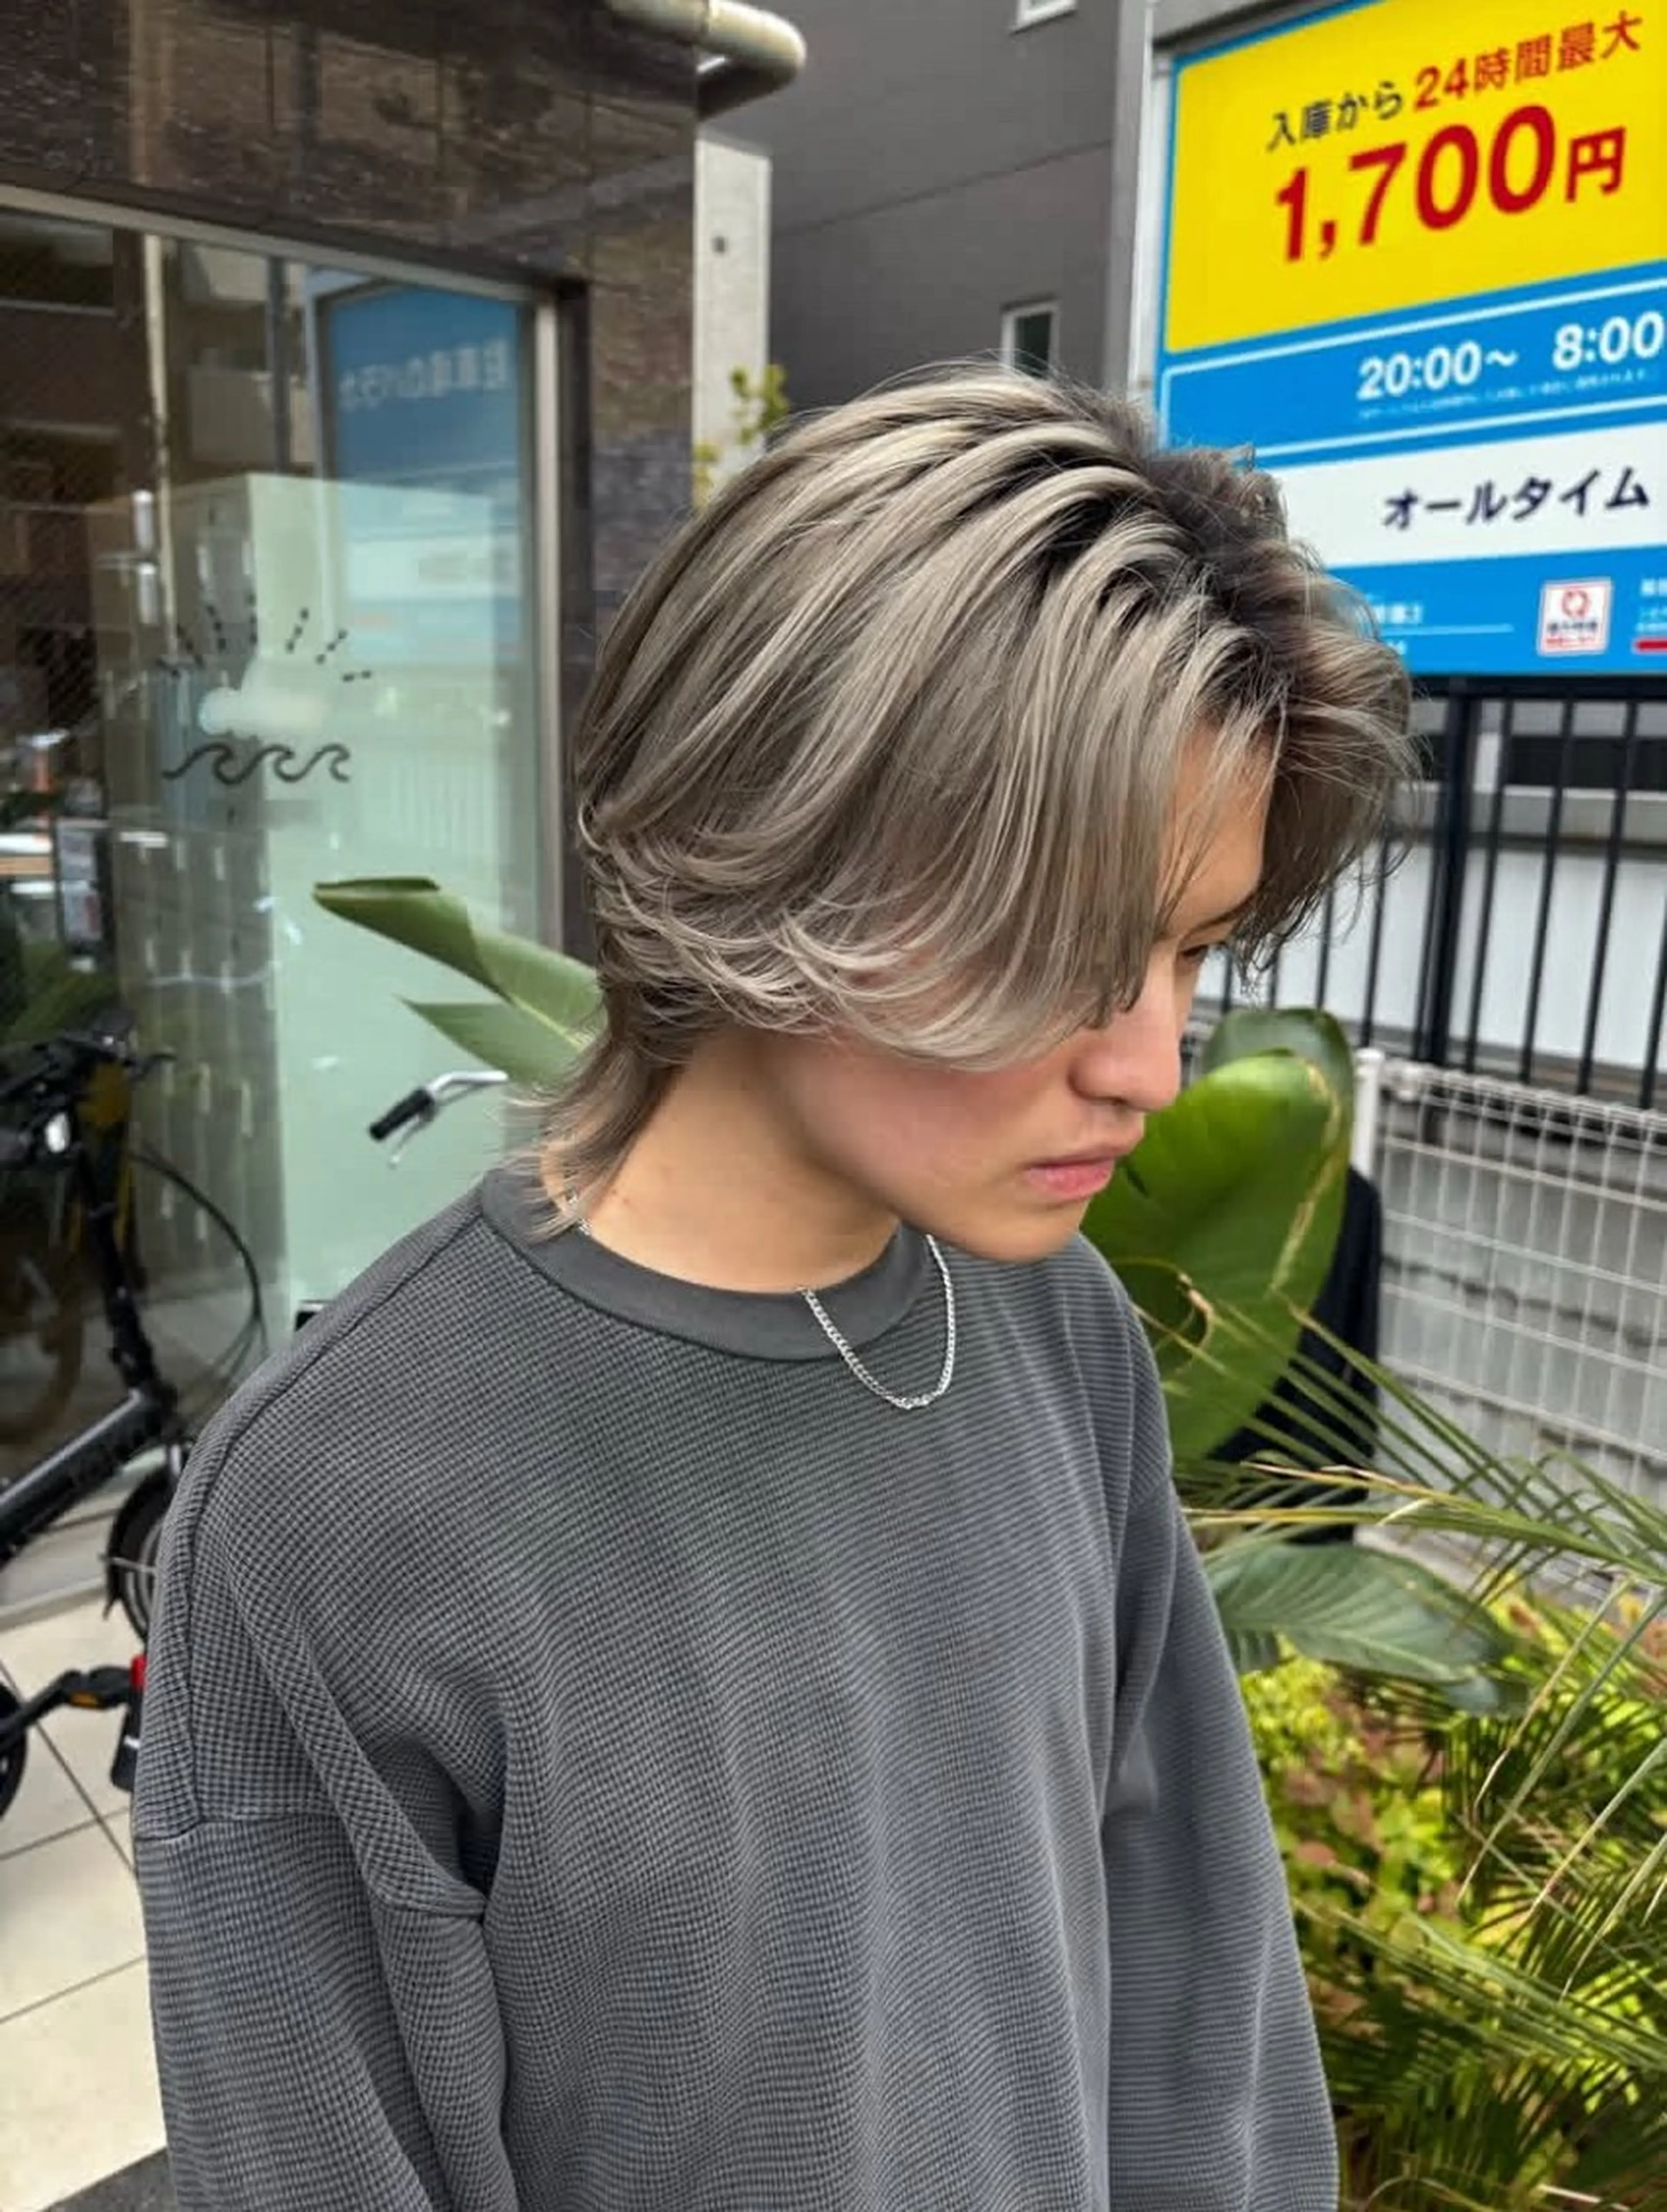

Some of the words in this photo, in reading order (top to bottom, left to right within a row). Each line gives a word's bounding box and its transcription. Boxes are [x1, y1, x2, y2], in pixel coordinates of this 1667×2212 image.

[1275, 105, 1626, 261] 1,700円
[1552, 312, 1666, 370] 8:00
[1384, 467, 1650, 529] オールタイム
